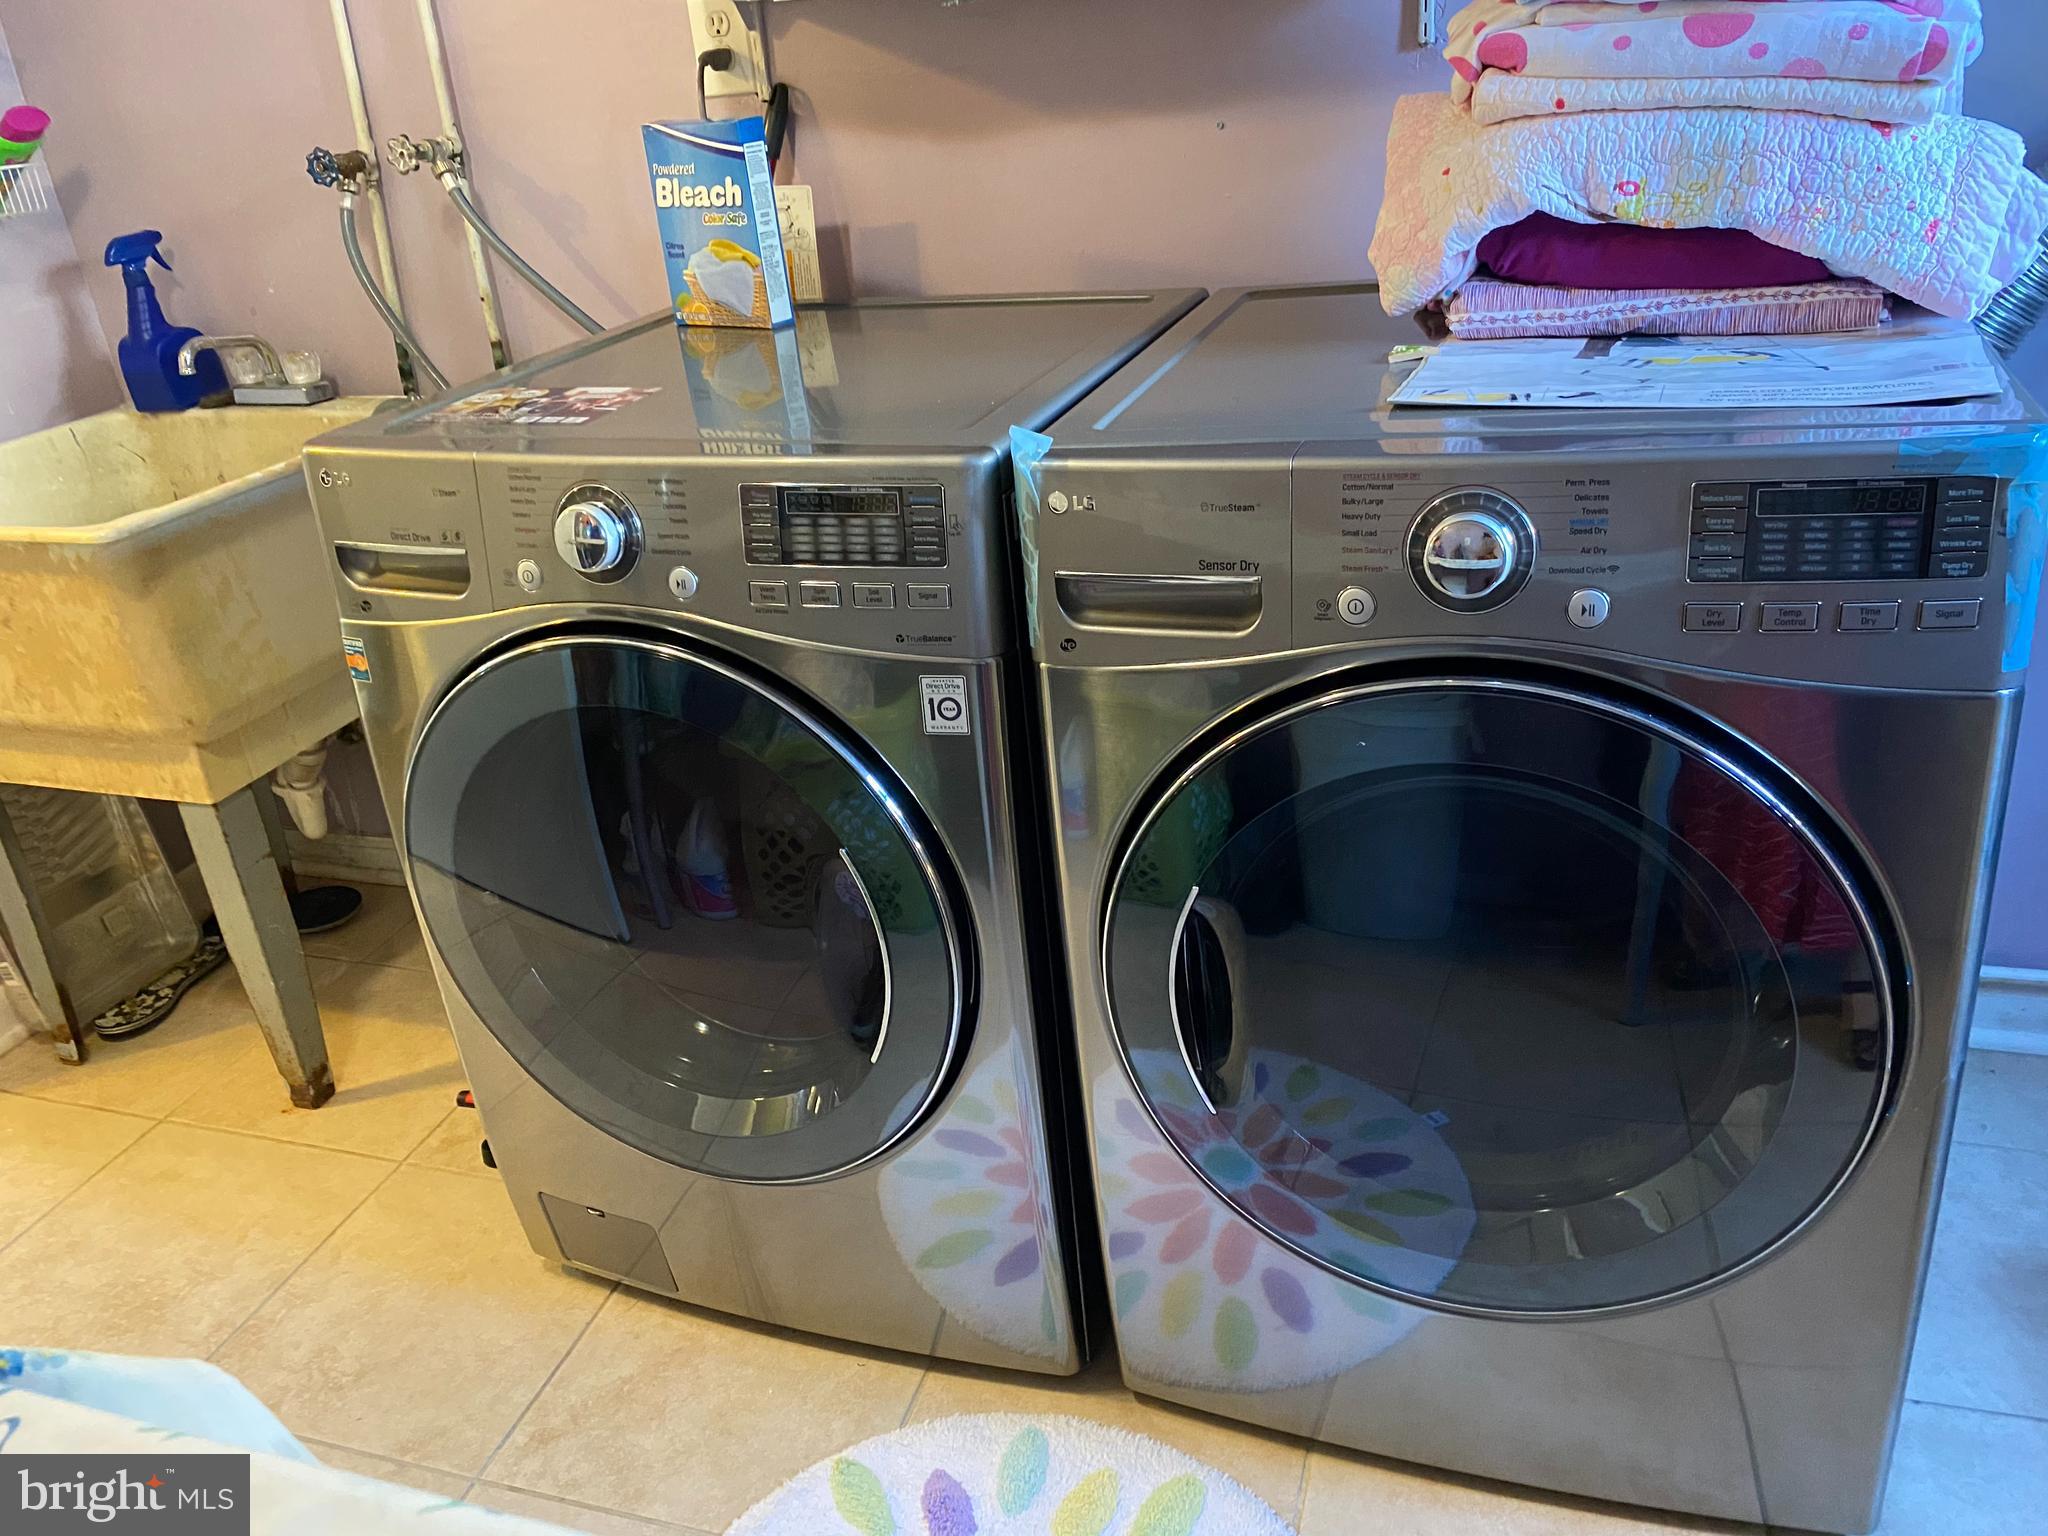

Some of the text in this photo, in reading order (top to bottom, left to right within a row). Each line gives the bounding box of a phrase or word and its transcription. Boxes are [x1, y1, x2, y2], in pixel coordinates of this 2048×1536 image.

[652, 162, 695, 176] Powdered
[655, 175, 743, 209] Bleach
[703, 212, 725, 225] Color
[726, 211, 748, 227] Safe
[1342, 483, 1394, 491] Cotton/Normal
[1589, 478, 1610, 487] Press
[1967, 488, 1984, 496] Time
[1341, 498, 1384, 507] Bulky/Large
[1574, 494, 1610, 502] Delicates
[1072, 494, 1096, 512] LG
[1210, 502, 1255, 512] TrueSteam
[1582, 508, 1609, 516] Towels
[1341, 513, 1381, 521] Heavy Duty
[1341, 529, 1378, 537] Small Load
[1569, 527, 1608, 536] Speed Dry
[390, 531, 411, 542] Direct
[412, 532, 431, 543] Drive
[1341, 546, 1364, 554] Steam
[1580, 547, 1607, 555] Air Dry
[1722, 544, 1732, 552] Dry
[1198, 559, 1260, 574] Sensor Dry
[1341, 565, 1363, 573] Steam
[1548, 565, 1607, 574] Download Cycle
[1942, 562, 1975, 570] Damp Dry
[1947, 569, 1969, 577] Signal
[918, 592, 938, 600] Signal
[1706, 608, 1722, 618] Dry
[1778, 608, 1802, 618] Temp
[1859, 607, 1881, 616] Time
[1935, 609, 1964, 620] Signal
[1702, 618, 1726, 627] Level
[1773, 617, 1807, 626] Control
[1860, 616, 1877, 626] Dry
[905, 634, 953, 643] TrueBalance
[925, 682, 944, 690] Direct
[928, 696, 962, 721] 10
